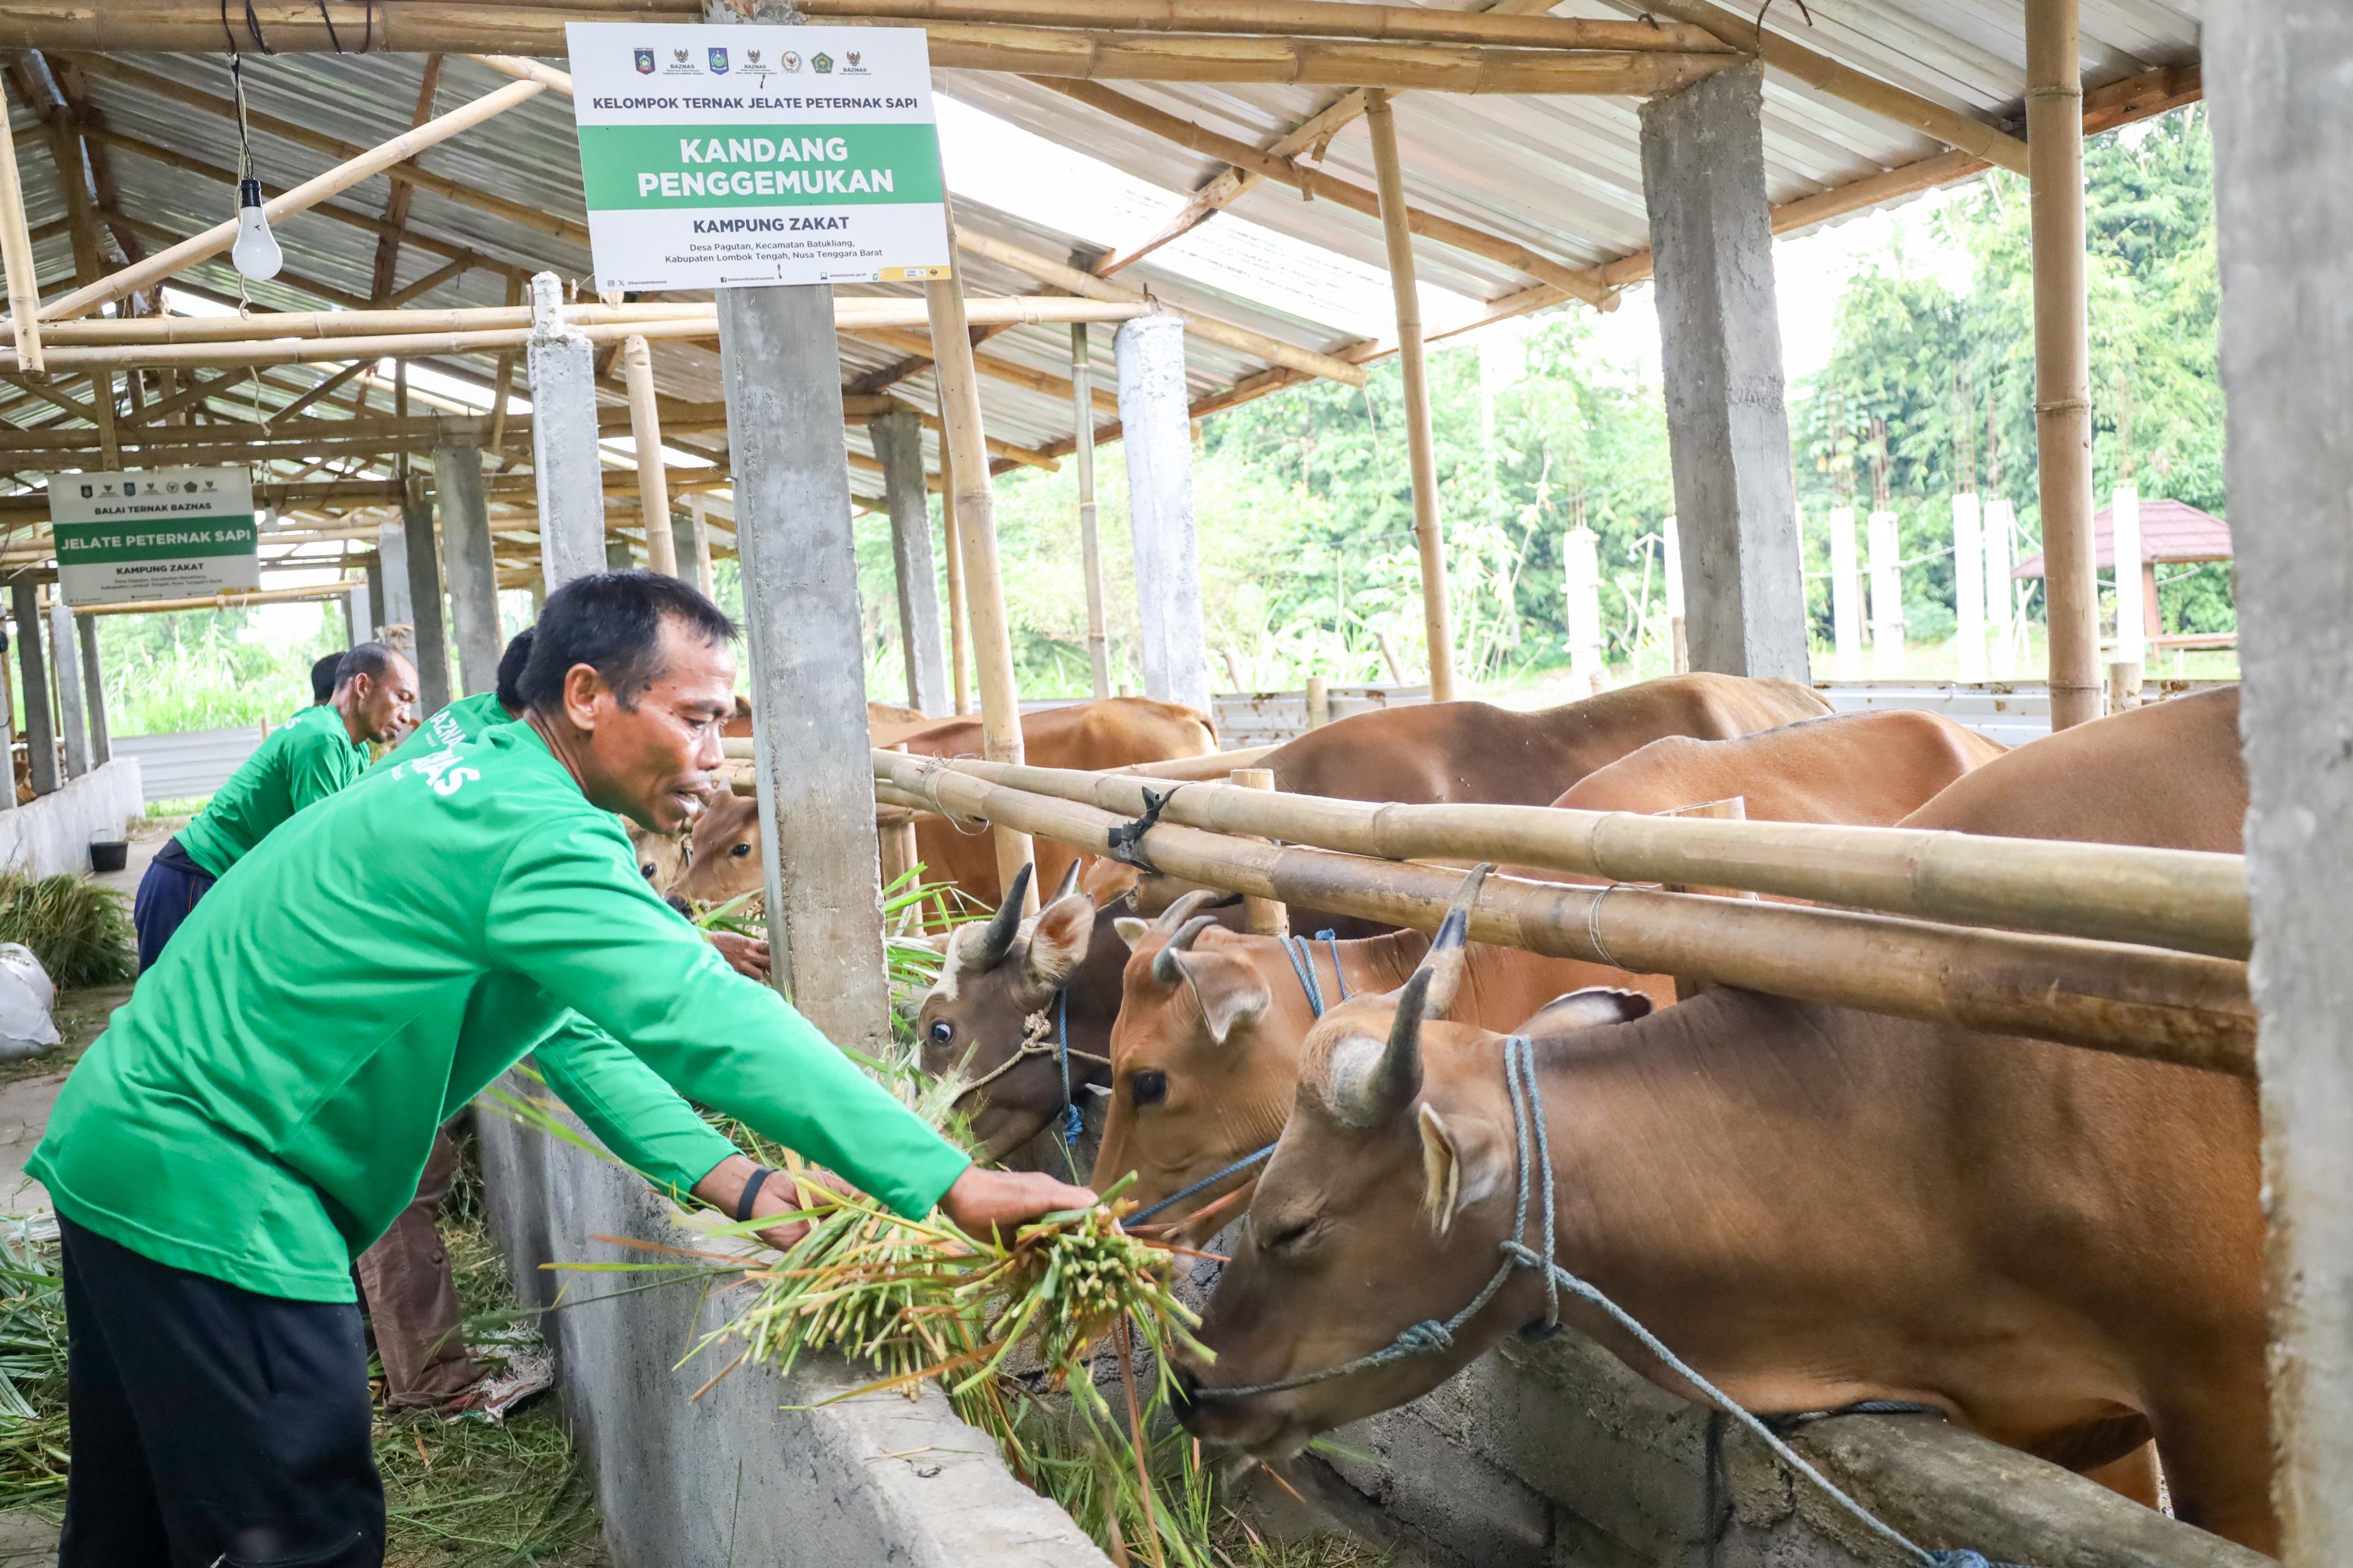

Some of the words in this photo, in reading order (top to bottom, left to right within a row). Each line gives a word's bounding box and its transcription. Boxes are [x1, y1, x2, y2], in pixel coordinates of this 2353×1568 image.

[593, 97, 679, 109] KELOMPOK
[682, 97, 744, 109] TERNAK
[748, 97, 802, 109] JELATE
[806, 97, 882, 109] PETERNAK
[885, 97, 918, 109] SAPI
[679, 137, 848, 163] KANDANG
[637, 169, 894, 197] PENGGEMUKAN
[693, 218, 785, 233] KAMPUNG
[789, 216, 850, 231] ZAKAT
[714, 243, 753, 252] Pagutan,
[756, 241, 804, 250] Kecamatan
[665, 255, 714, 264] Kabupaten
[755, 252, 791, 261] Tengah,
[94, 507, 126, 515] BALAI
[128, 504, 168, 513] TERNAK
[171, 502, 212, 511] BAZNAS
[61, 536, 122, 551] JELATE
[126, 531, 212, 547] PETERNAK
[214, 529, 251, 542] SAPI
[117, 565, 167, 575] KAMPUNG
[170, 563, 204, 572] ZAKAT
[430, 710, 467, 750] AZNA
